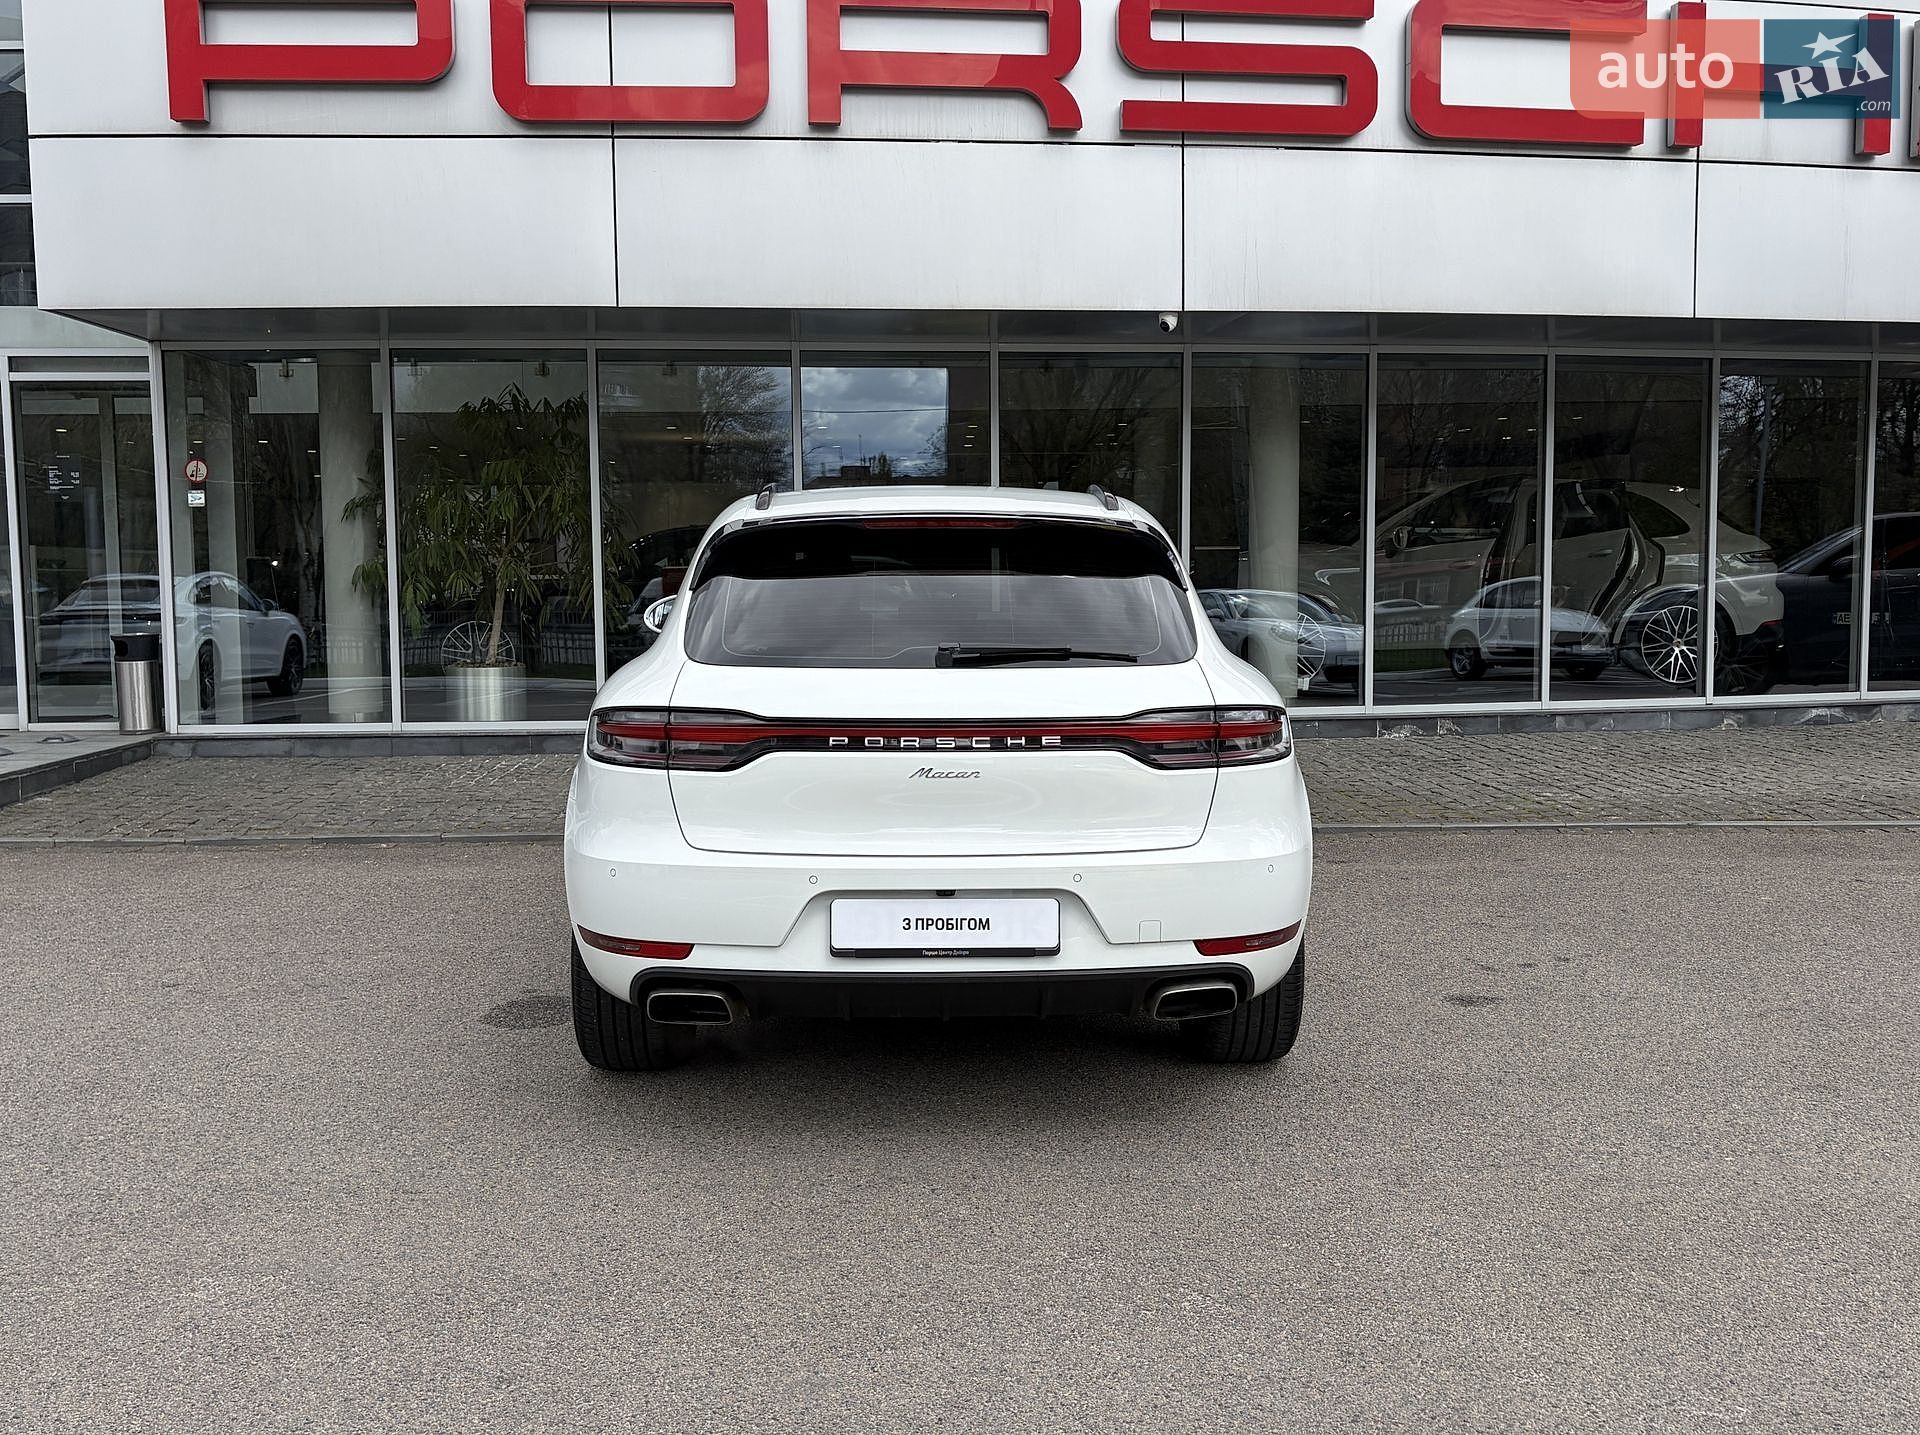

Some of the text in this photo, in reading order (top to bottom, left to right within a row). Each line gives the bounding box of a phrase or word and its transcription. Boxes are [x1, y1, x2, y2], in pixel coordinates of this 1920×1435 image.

[166, 0, 1920, 158] PORSCH
[829, 735, 1062, 748] PORSCHE
[908, 767, 981, 779] Macan
[915, 917, 991, 931] ПРОБІГОМ
